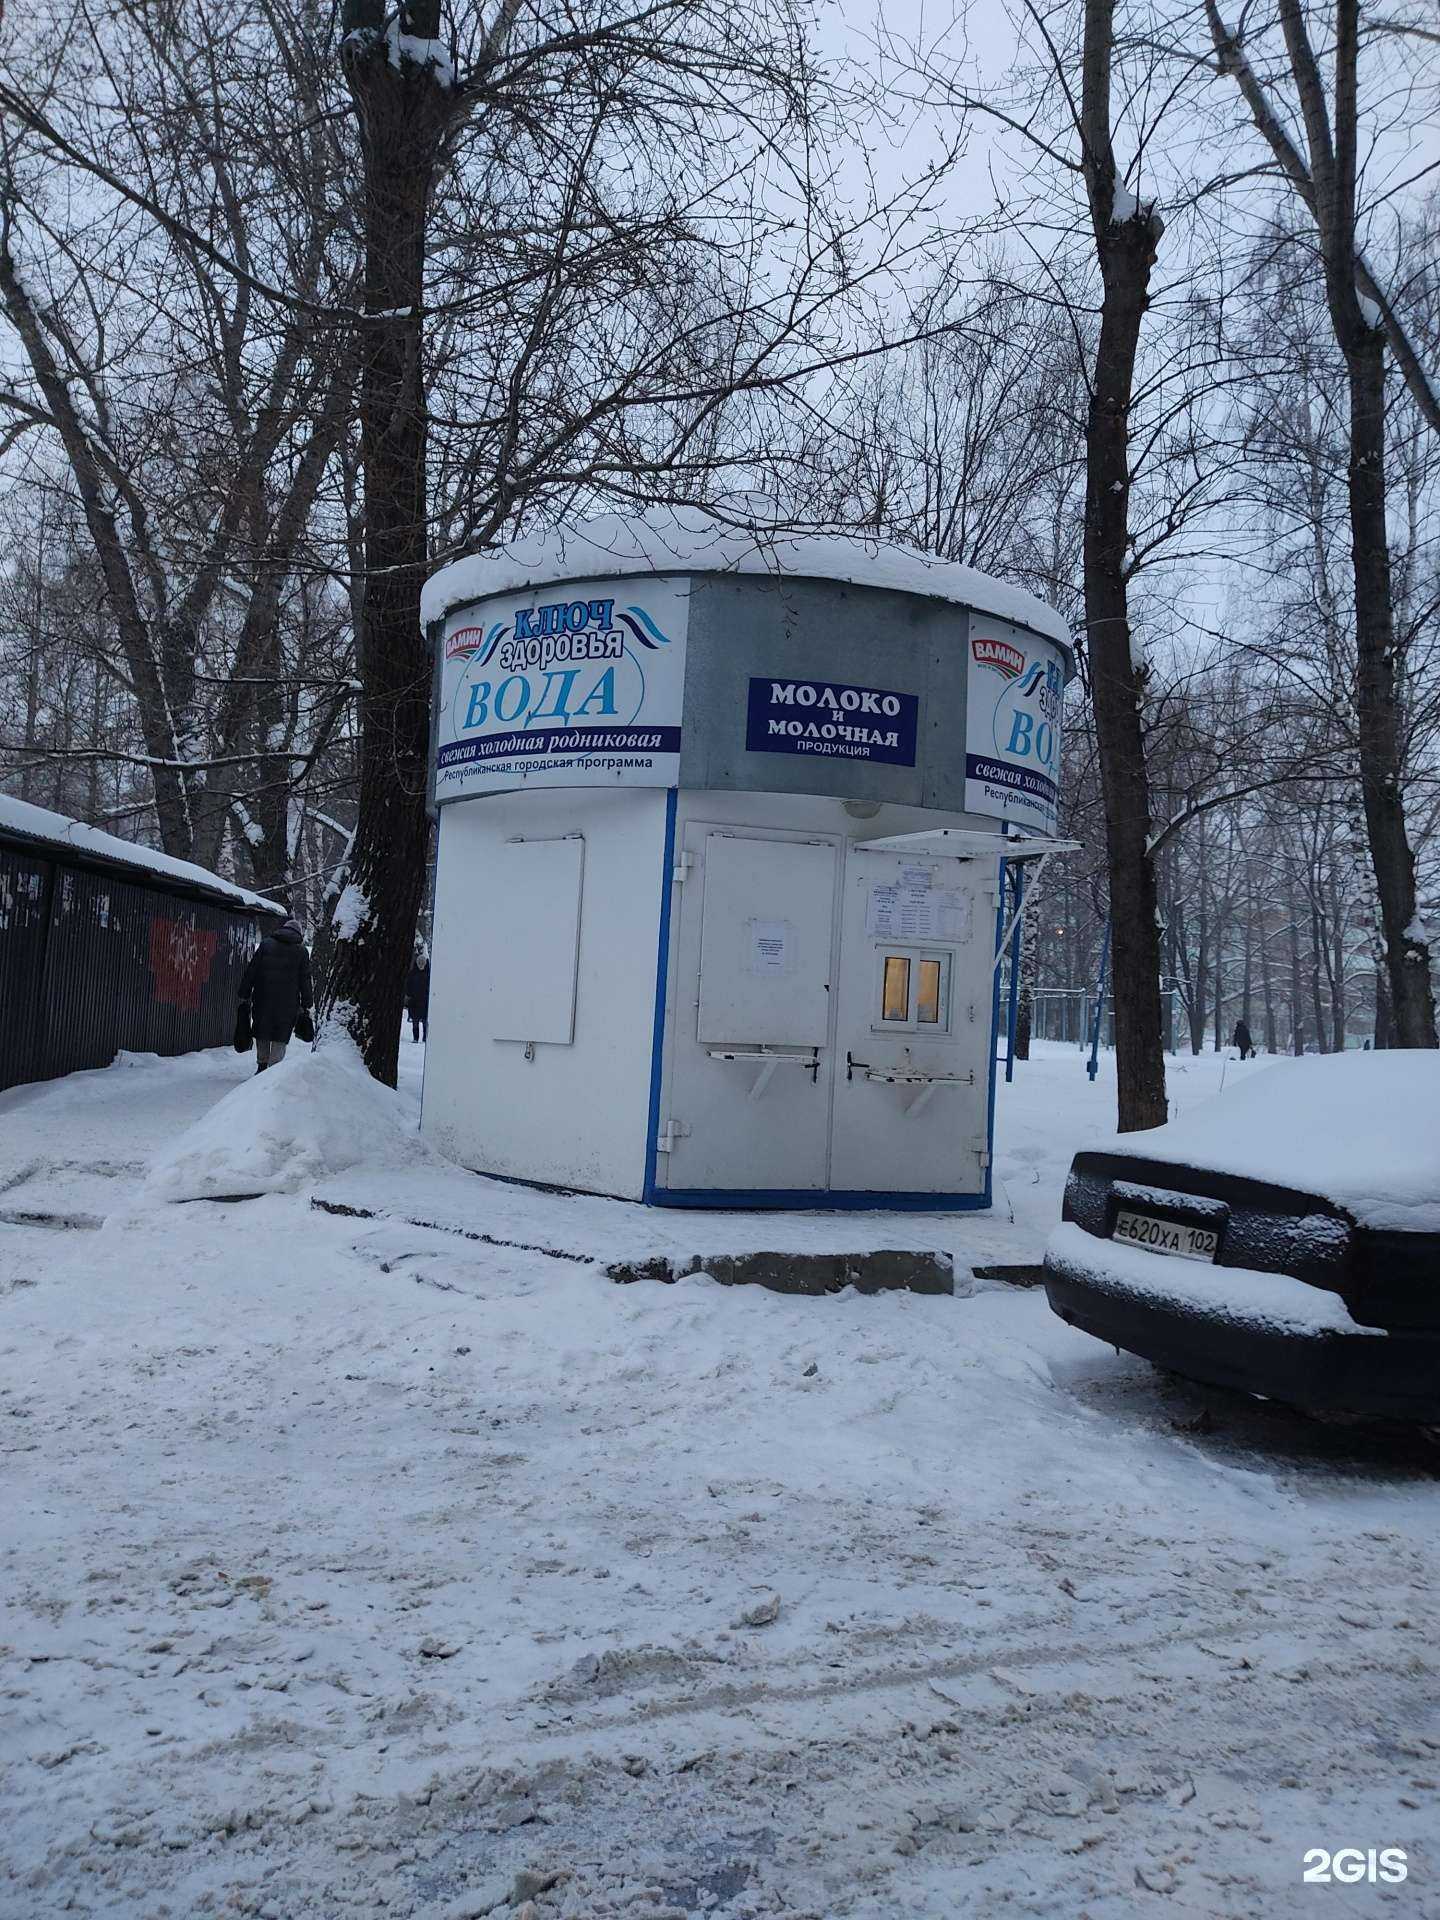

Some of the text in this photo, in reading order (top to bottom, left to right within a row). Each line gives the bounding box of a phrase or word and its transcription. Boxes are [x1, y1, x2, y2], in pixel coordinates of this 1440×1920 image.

[513, 598, 615, 640] КЛЮЧ
[974, 642, 1023, 671] ВАМИН
[462, 666, 618, 729] ВОДА
[770, 683, 900, 716] МОЛОКО
[440, 729, 663, 765] свежая холодная родниковая
[768, 720, 899, 747] МОЛОЧНАЯ
[1004, 709, 1058, 777] ВО
[797, 740, 870, 757] ПРОДУКЦИЯ
[444, 758, 653, 781] Республиканская городская программа
[975, 763, 1021, 786] свежая
[1187, 1230, 1215, 1251] 102
